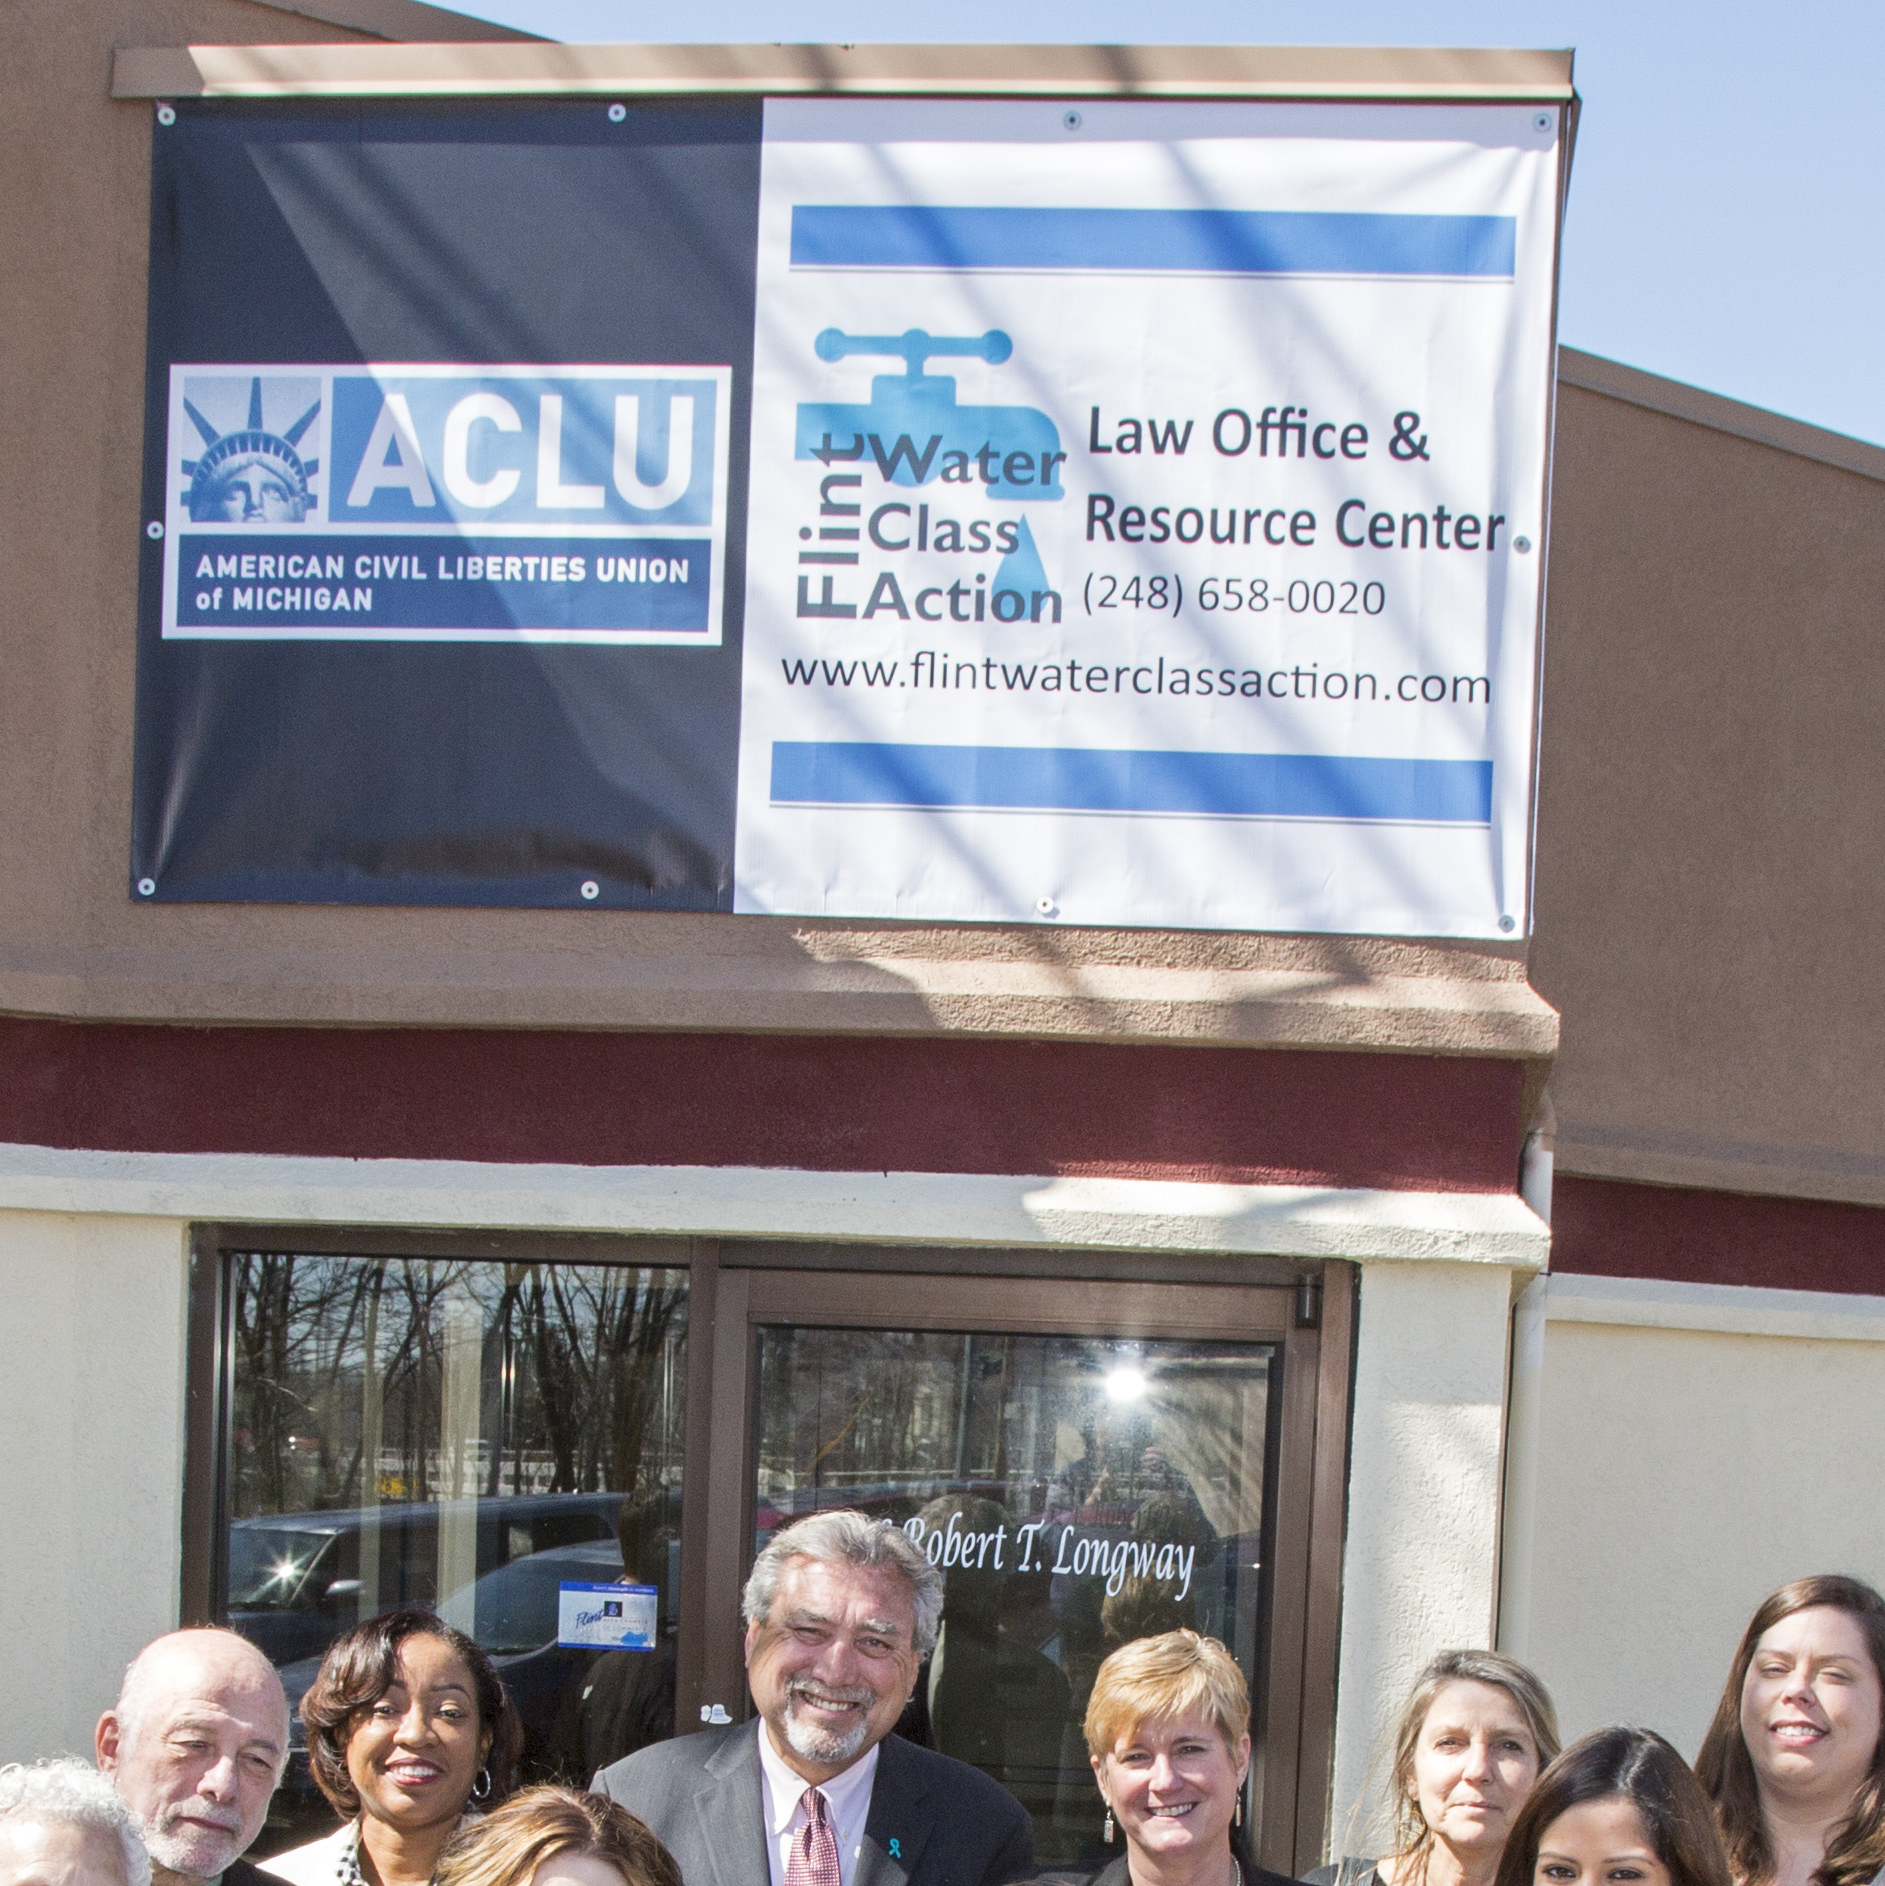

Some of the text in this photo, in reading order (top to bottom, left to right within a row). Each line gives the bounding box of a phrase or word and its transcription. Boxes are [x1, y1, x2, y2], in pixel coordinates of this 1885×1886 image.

[347, 392, 695, 510] ACLU
[866, 433, 1068, 486] Water
[1088, 405, 1431, 461] Law Office &
[796, 432, 864, 619] Flint
[868, 502, 1020, 554] Class
[1085, 492, 1506, 552] Resource Center
[195, 555, 690, 583] AMERICAN CIVIL LIBERTIES UNION
[1083, 572, 1387, 619] (248) 658-0020
[195, 587, 373, 612] of MICHIGAN
[862, 571, 1063, 624] Action
[781, 650, 1492, 704] www.flintwaterclassaction.com
[1016, 1519, 1045, 1572] T.
[1051, 1525, 1195, 1601] Longway
[576, 1609, 604, 1629] Flint
